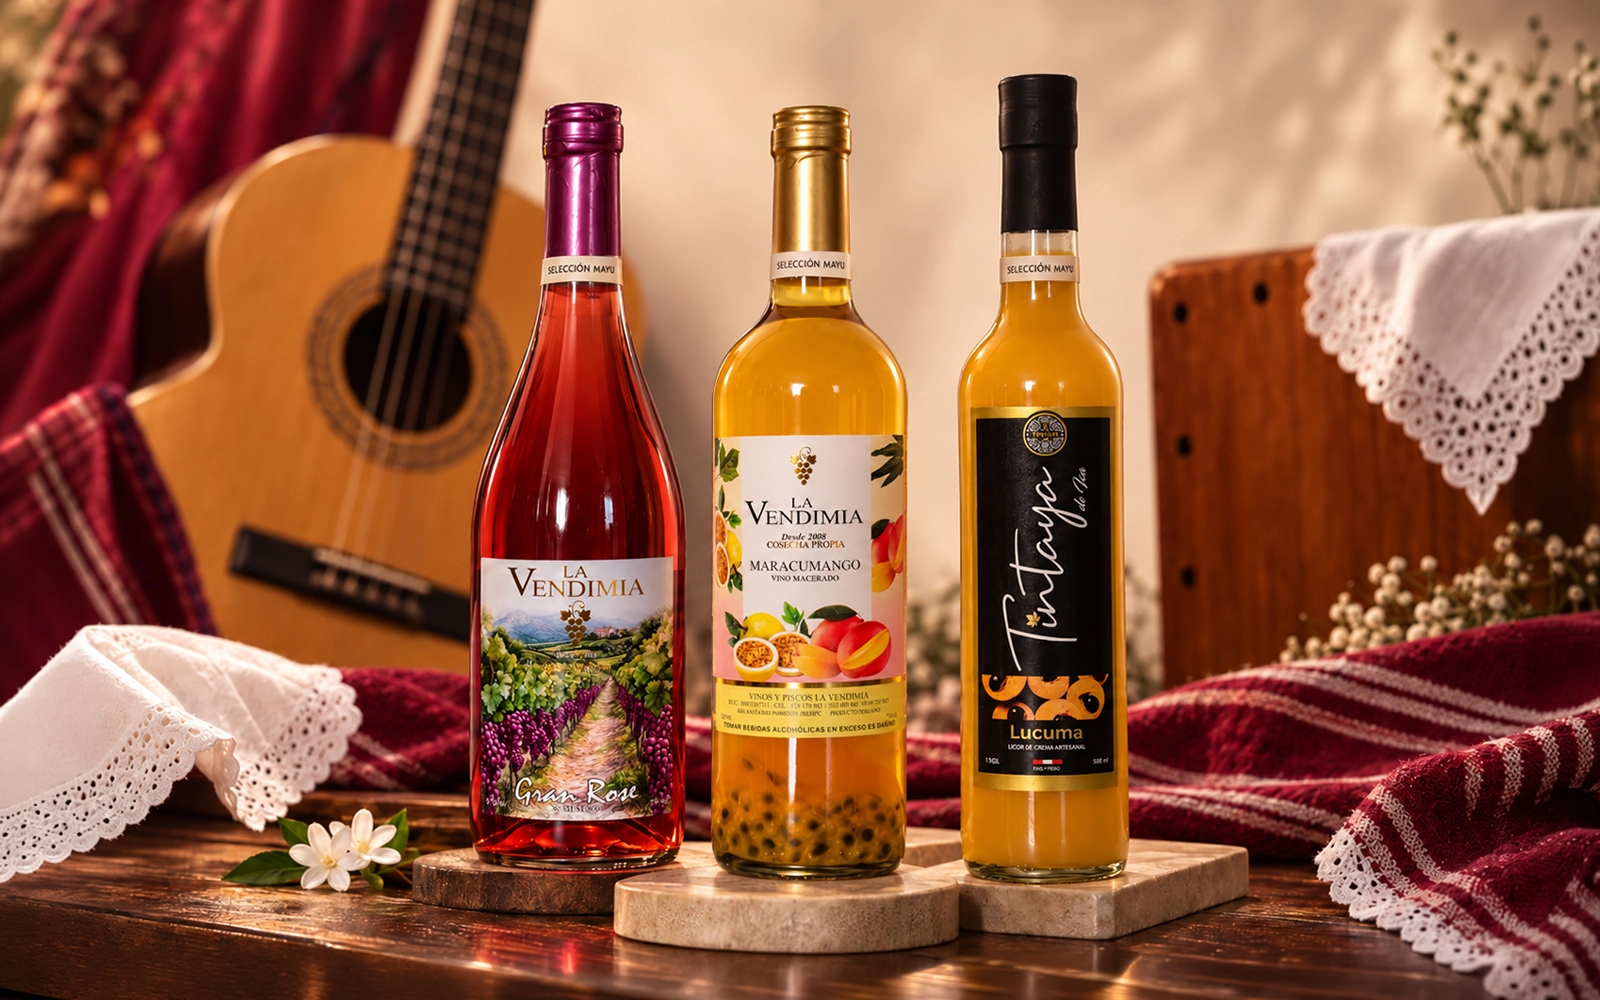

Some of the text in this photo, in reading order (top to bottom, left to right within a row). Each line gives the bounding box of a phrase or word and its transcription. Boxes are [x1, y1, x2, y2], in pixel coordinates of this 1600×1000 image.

[548, 261, 615, 275] SELECCIÓN MAYU
[776, 258, 845, 270] SELECCIÓN MAYU
[1007, 262, 1074, 274] SELECCIÓN MAYU
[790, 497, 813, 508] LA
[812, 540, 845, 548] PROPIA
[563, 565, 588, 578] LA
[750, 560, 860, 572] MARACUMANGO
[1002, 466, 1088, 672] Tintaya
[749, 692, 772, 700] VINOS
[828, 692, 869, 700] VENDIMIA
[724, 721, 742, 730] TOMAR
[742, 724, 770, 732] BEBIDAS
[1010, 724, 1083, 740] Lucuma
[515, 777, 578, 806] Gran
[587, 778, 638, 804] Rose
